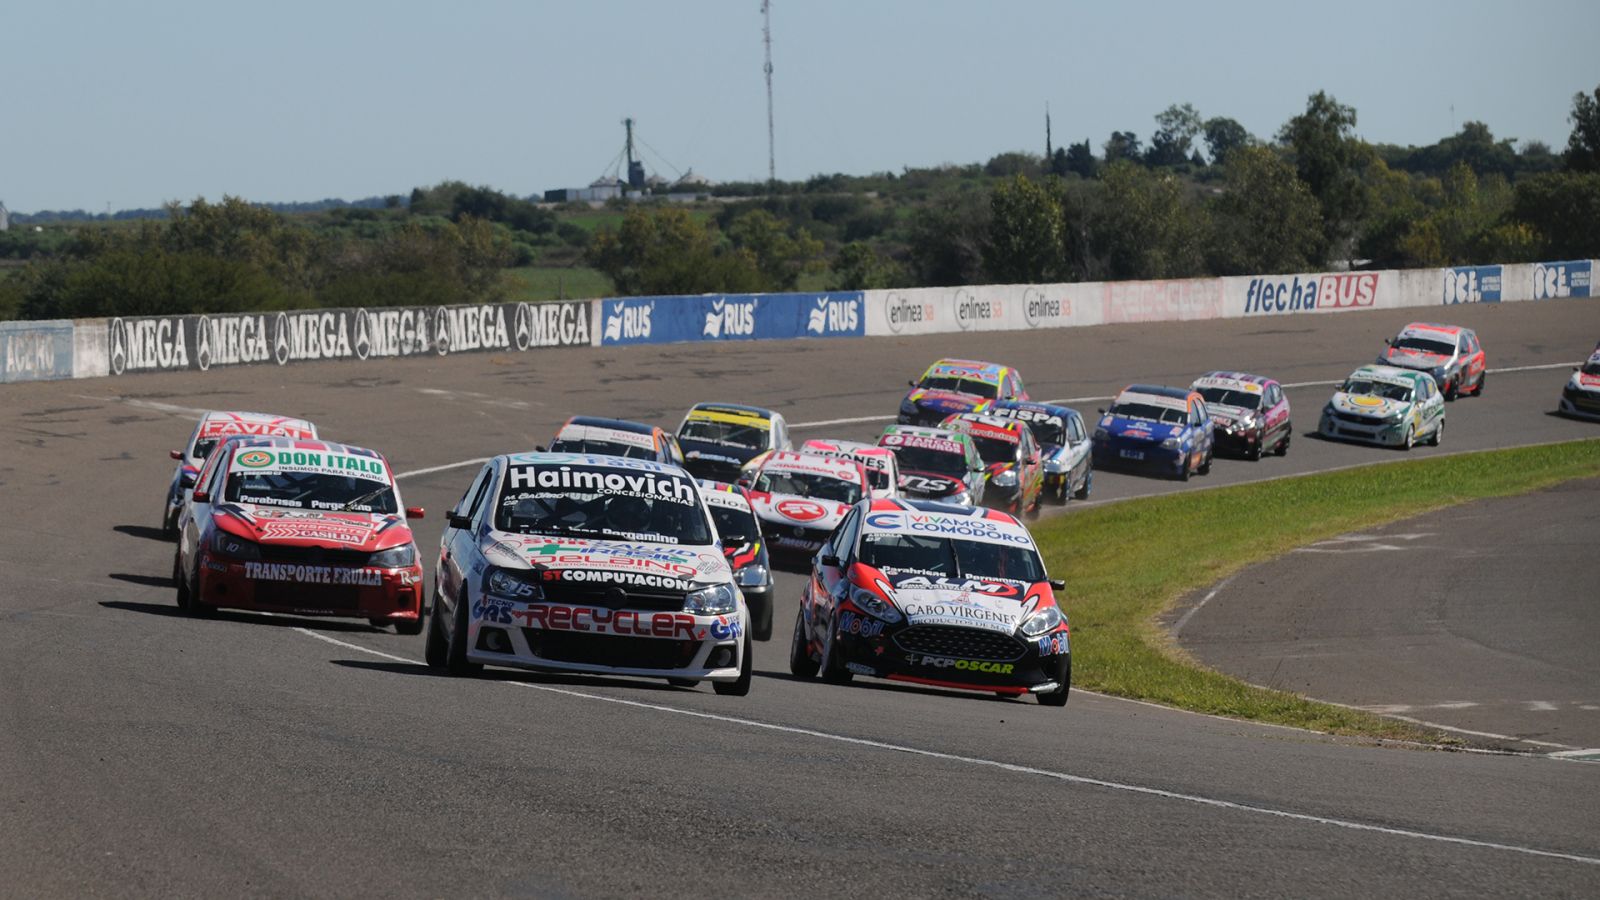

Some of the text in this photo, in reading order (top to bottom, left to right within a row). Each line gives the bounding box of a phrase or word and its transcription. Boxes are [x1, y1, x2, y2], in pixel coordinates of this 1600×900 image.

[829, 300, 858, 331] RUS
[890, 298, 922, 323] enlinea
[959, 296, 990, 319] enlinea
[1029, 294, 1060, 317] enlinea
[449, 305, 509, 351] MEGA
[530, 303, 589, 347] MEGA
[624, 304, 651, 338] RUS
[724, 301, 754, 335] RUS
[126, 319, 188, 369] MEGA
[211, 315, 269, 364] MEGA
[289, 312, 352, 359] MEGA
[278, 451, 382, 475] DON ITALO
[360, 473, 383, 481] AGRO
[510, 467, 694, 501] Haimovich
[240, 495, 302, 507] Parabrisas
[597, 488, 695, 507] CONCESIONARIAS
[911, 515, 997, 531] VIVAMOS
[911, 523, 1030, 545] COMODORO
[226, 542, 240, 552] 10
[301, 530, 360, 543] CASILDA
[245, 561, 330, 583] TRANSPORTE
[333, 567, 382, 586] FRULLA
[516, 583, 534, 596] 15
[473, 599, 513, 624] GAS
[905, 604, 945, 616] CABO
[840, 612, 884, 638] Mobil
[1039, 633, 1068, 656] Mobil
